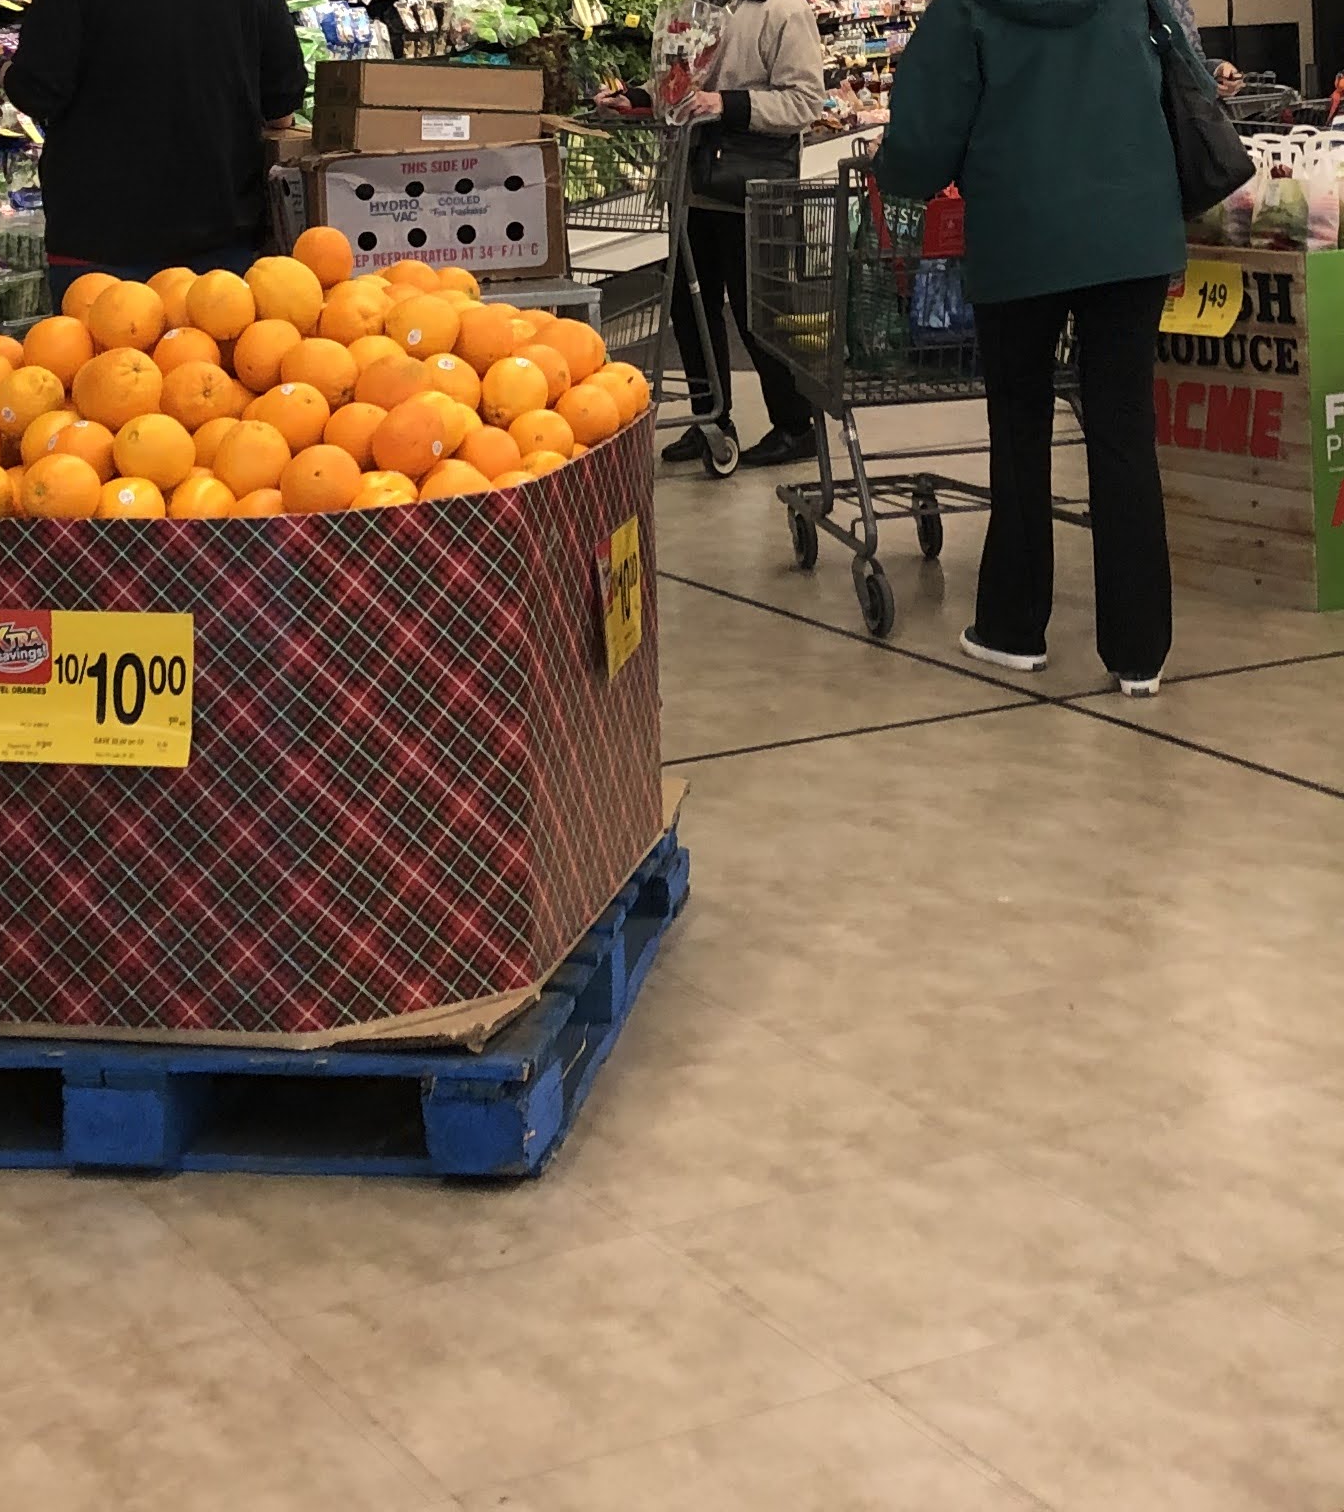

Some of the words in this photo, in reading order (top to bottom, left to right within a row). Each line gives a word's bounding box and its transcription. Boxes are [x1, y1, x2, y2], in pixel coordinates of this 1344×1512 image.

[400, 162, 428, 175] THIS
[431, 160, 458, 173] SIDE
[461, 158, 478, 171] UP
[369, 199, 420, 213] HYDRO
[438, 195, 480, 206] COOLED
[393, 211, 418, 222] VAC
[353, 254, 369, 267] EP
[373, 248, 457, 268] REFRIGERATED
[461, 247, 476, 260] AT
[1157, 333, 1299, 376] ODUCE
